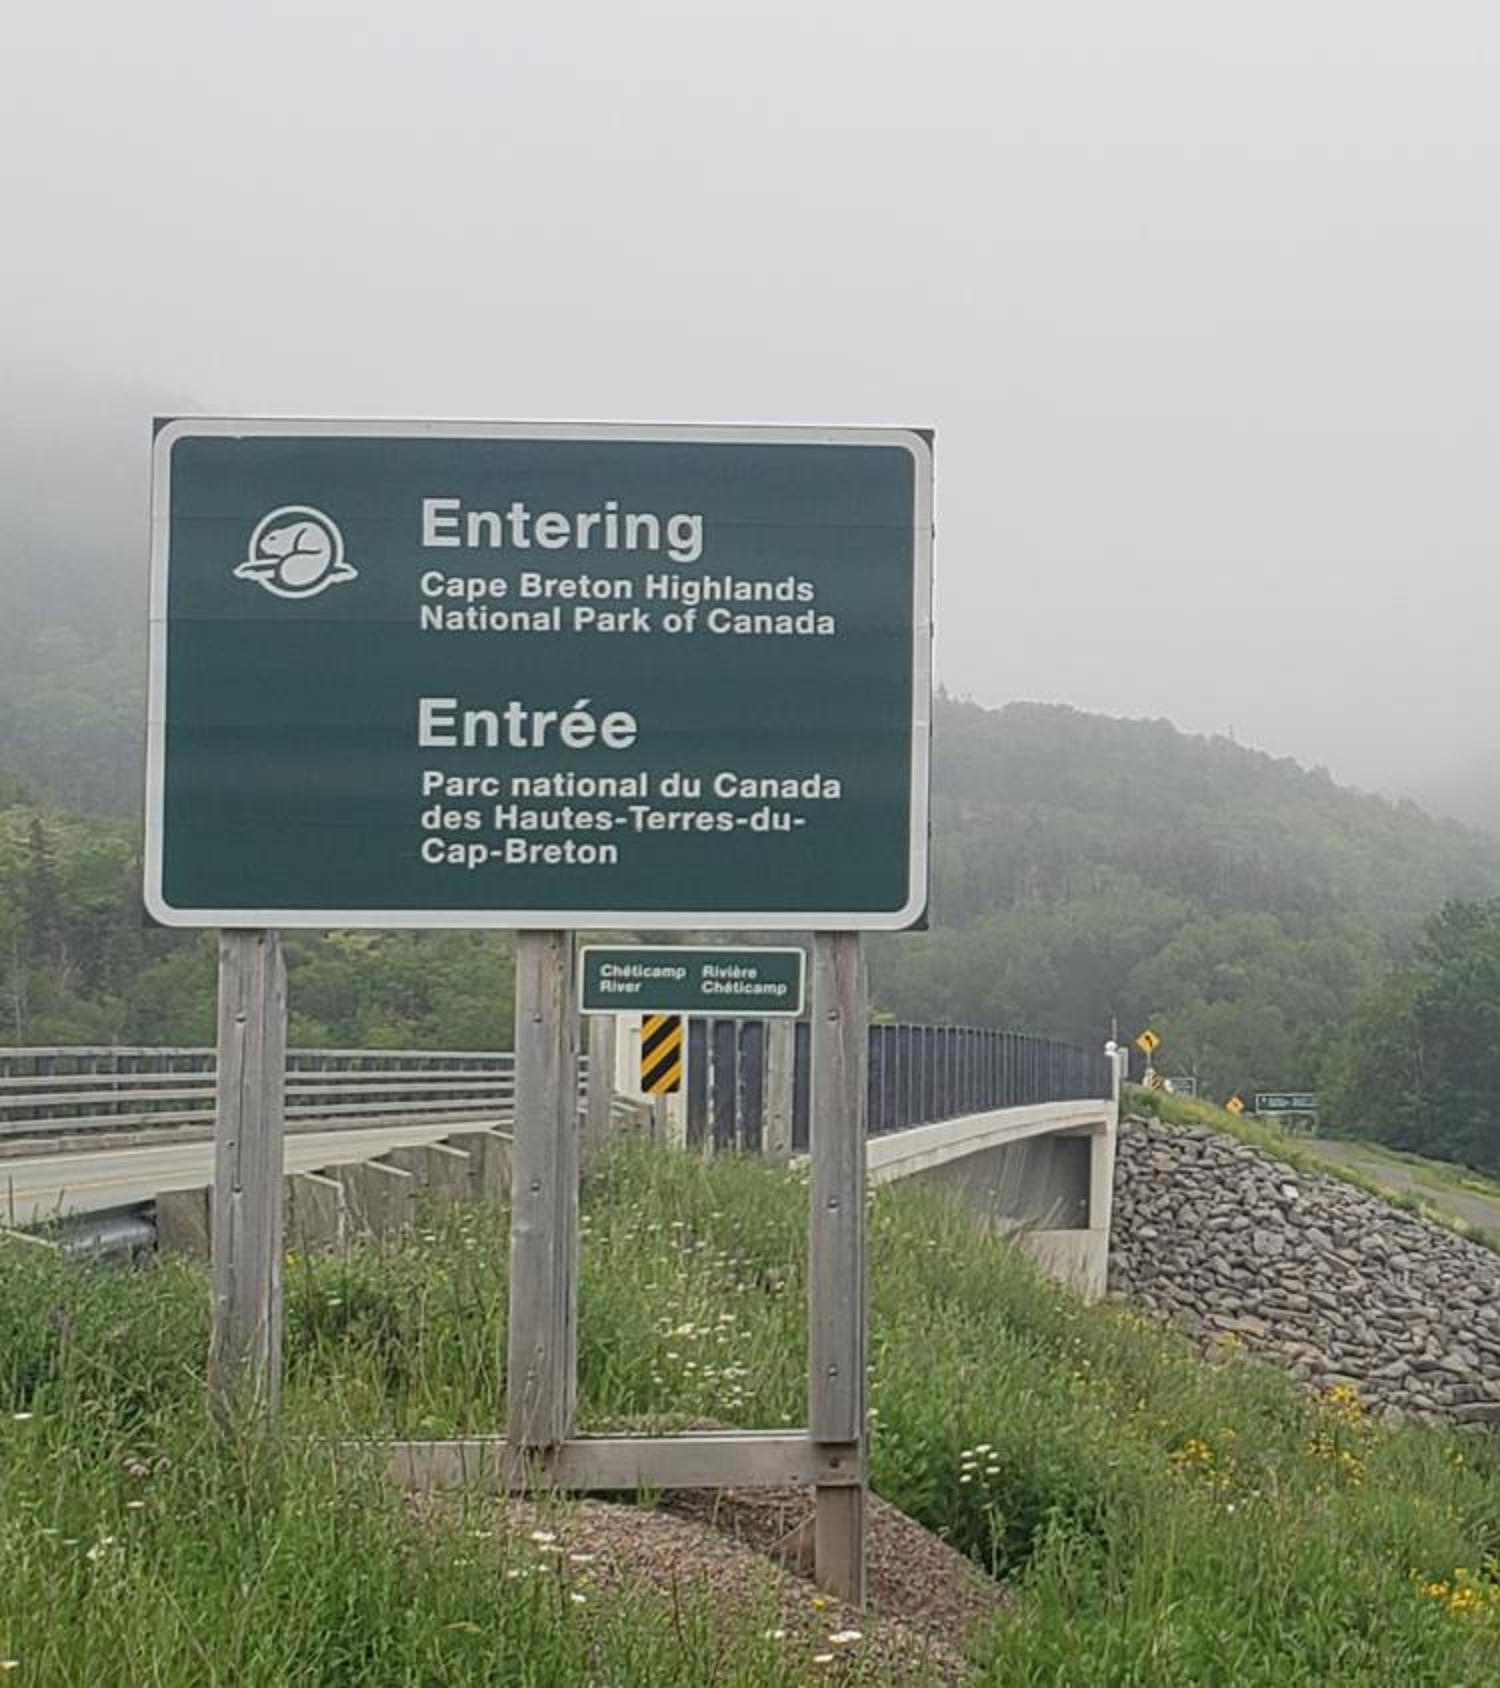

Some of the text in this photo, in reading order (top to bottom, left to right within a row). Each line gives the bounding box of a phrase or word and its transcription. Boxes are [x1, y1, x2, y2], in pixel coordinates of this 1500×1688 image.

[422, 498, 703, 563] Entering
[420, 571, 814, 606] Cape Breton Highlands
[420, 604, 835, 635] National Park of Canada
[418, 697, 637, 749] Entrée
[422, 770, 841, 799] Parc national du Canada
[421, 804, 805, 833] des Hautes-Terres-du-
[421, 837, 618, 869] Cap-Breton
[599, 963, 687, 980] Chéticamp
[599, 979, 642, 993] River
[701, 964, 758, 979] Rivière
[700, 979, 788, 997] Chéticamp
